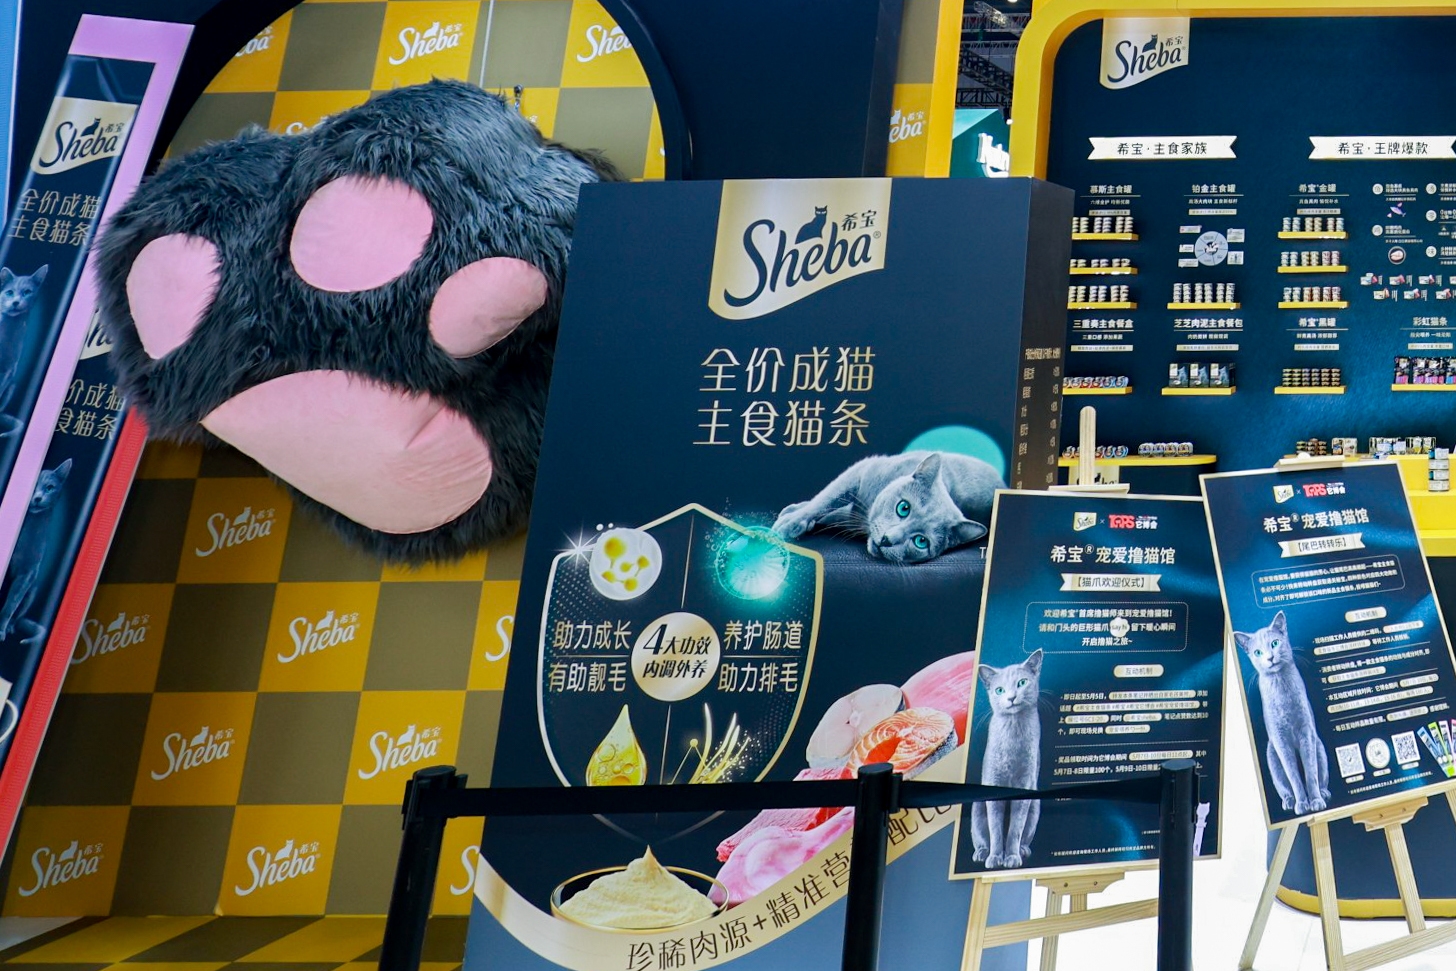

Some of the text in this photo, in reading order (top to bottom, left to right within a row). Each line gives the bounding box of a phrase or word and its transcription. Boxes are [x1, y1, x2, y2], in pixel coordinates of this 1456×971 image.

[389, 27, 459, 66] Sheba
[1165, 36, 1184, 47] 希宝
[1107, 39, 1182, 84] Sheba
[38, 121, 119, 168] Sheba
[1116, 142, 1208, 156] 希宝·主食家族
[1337, 141, 1429, 156] 希宝·王牌爆款
[20, 188, 102, 219] 全价成猫
[840, 209, 877, 232] 希宝
[8, 217, 91, 247] 主食猫条
[723, 218, 872, 308] Sheba
[699, 346, 877, 394] 全价成猫
[692, 400, 870, 448] 主食猫条
[195, 510, 273, 557] Sheba
[1077, 576, 1146, 588] 【猫爪欢迎仪式】
[70, 618, 146, 665] Sheba
[277, 616, 355, 663] Sheba
[553, 620, 632, 651] 助力成长
[642, 623, 710, 655] 4大功效
[723, 620, 804, 651] 养护肠道
[547, 661, 627, 692] 有助靓毛
[641, 658, 709, 680] 内调外养
[717, 661, 799, 692] 助力排毛
[150, 731, 230, 781] Sheba
[358, 730, 438, 780] Sheba
[18, 847, 99, 898] Sheba
[235, 846, 316, 897] Sheba
